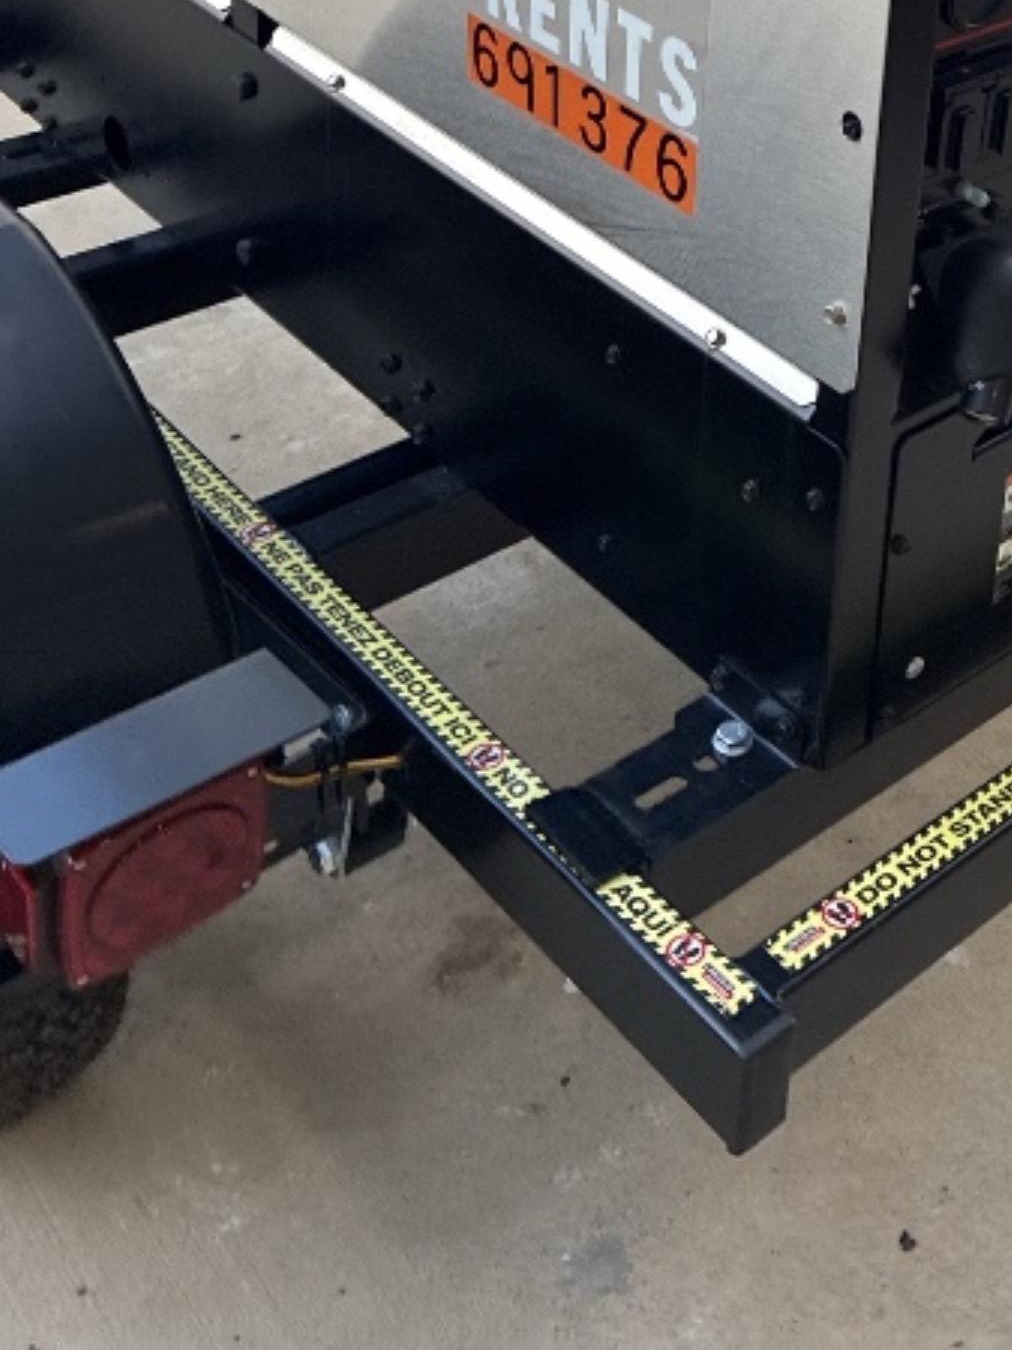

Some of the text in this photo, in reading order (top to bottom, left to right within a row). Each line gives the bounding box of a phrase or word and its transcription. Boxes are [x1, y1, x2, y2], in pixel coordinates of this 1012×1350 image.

[472, 21, 689, 203] 691376
[286, 559, 322, 596] PAS
[319, 591, 377, 649] TENEZ
[371, 642, 450, 723] DEBOUT
[443, 716, 478, 746] ICI
[495, 768, 529, 800] NO
[856, 872, 898, 905] DO
[899, 838, 950, 877] NOT
